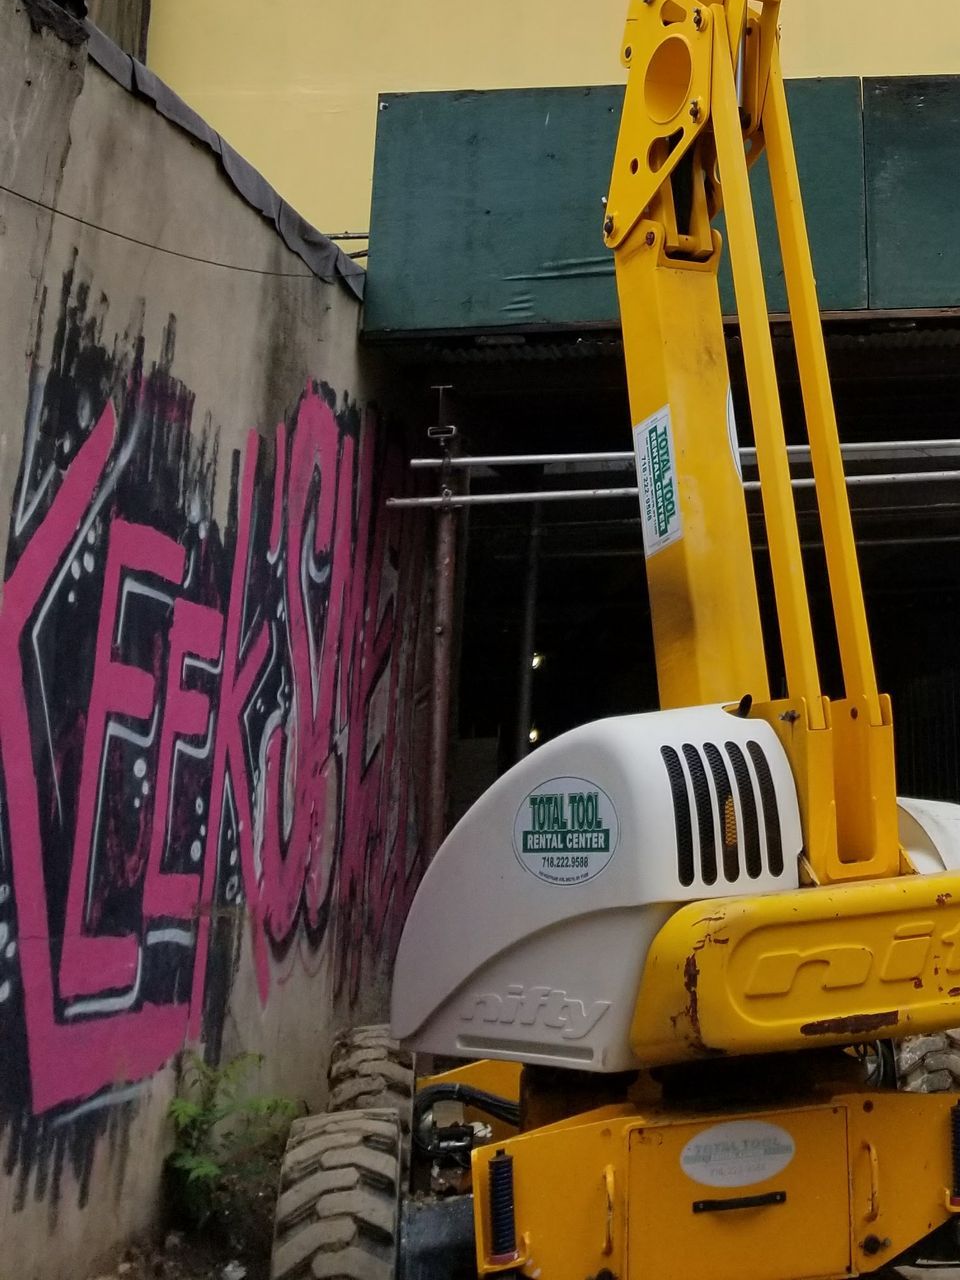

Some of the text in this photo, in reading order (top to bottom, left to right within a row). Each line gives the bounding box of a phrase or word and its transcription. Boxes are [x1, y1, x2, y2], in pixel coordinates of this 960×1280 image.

[650, 431, 661, 480] RENTAL
[657, 425, 677, 522] TOTAL TOOL
[655, 482, 667, 532] CENTER
[529, 792, 603, 831] TOTAL TOOL
[527, 833, 605, 849] RENTAL CENTER
[542, 856, 589, 868] 718.222.9588
[459, 984, 613, 1041] nifty
